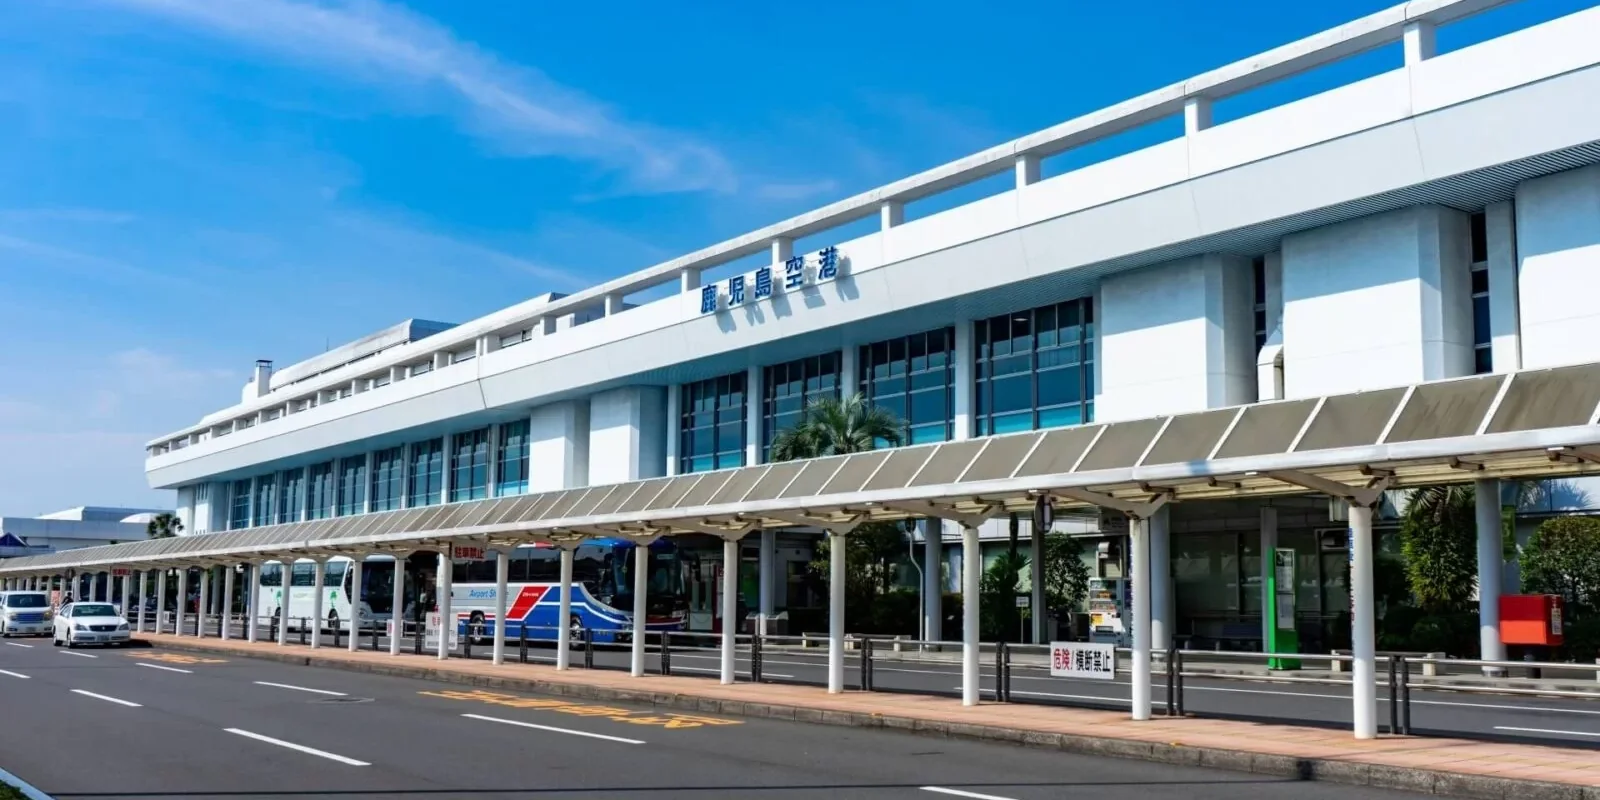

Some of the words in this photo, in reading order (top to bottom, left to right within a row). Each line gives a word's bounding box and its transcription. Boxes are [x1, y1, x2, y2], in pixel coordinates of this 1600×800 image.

[701, 246, 839, 314] 鹿児島空港
[469, 589, 488, 598] Airport
